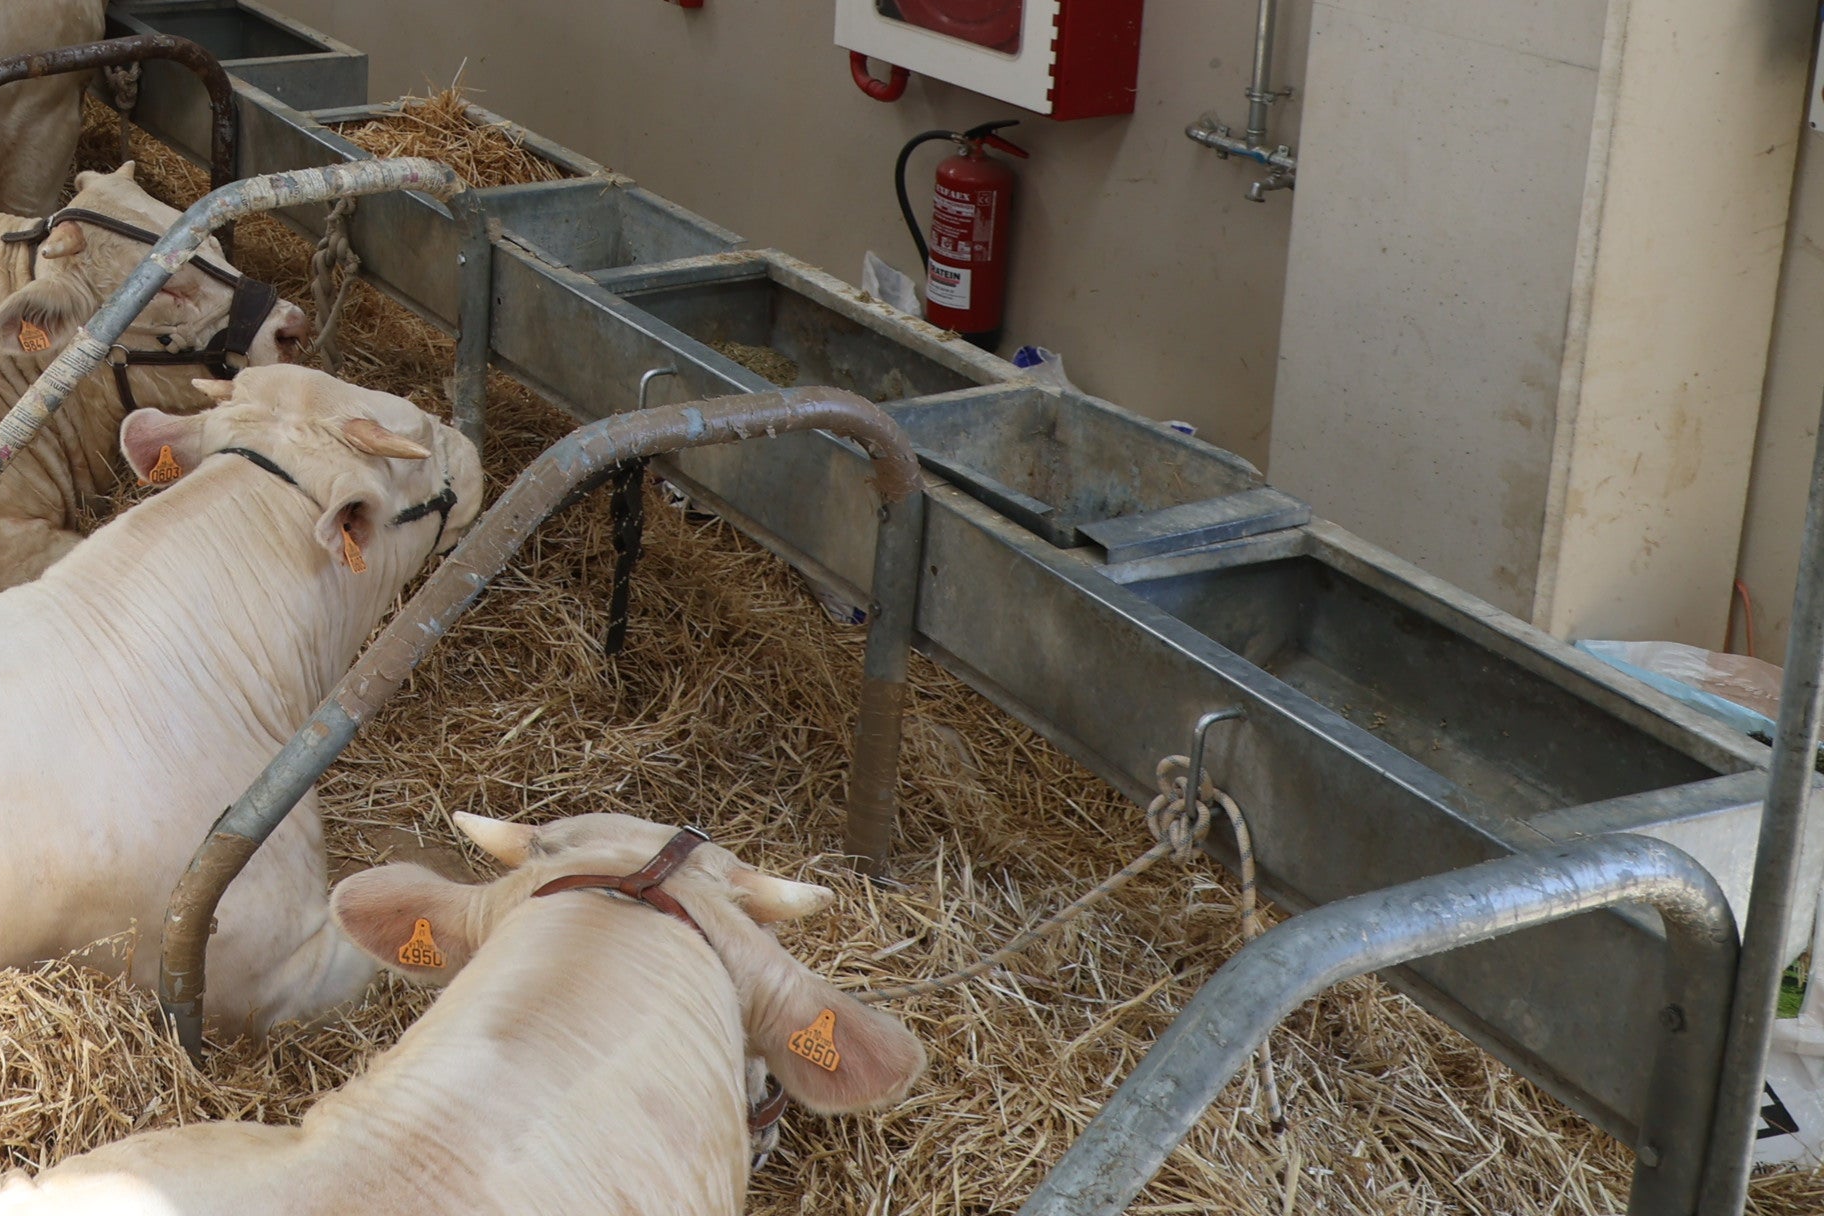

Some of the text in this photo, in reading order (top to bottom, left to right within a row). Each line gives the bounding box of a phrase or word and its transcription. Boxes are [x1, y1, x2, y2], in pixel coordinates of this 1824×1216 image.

[23, 337, 47, 352] 9847
[151, 467, 180, 483] 0603
[401, 947, 443, 967] 4950
[792, 1033, 836, 1068] 4950
